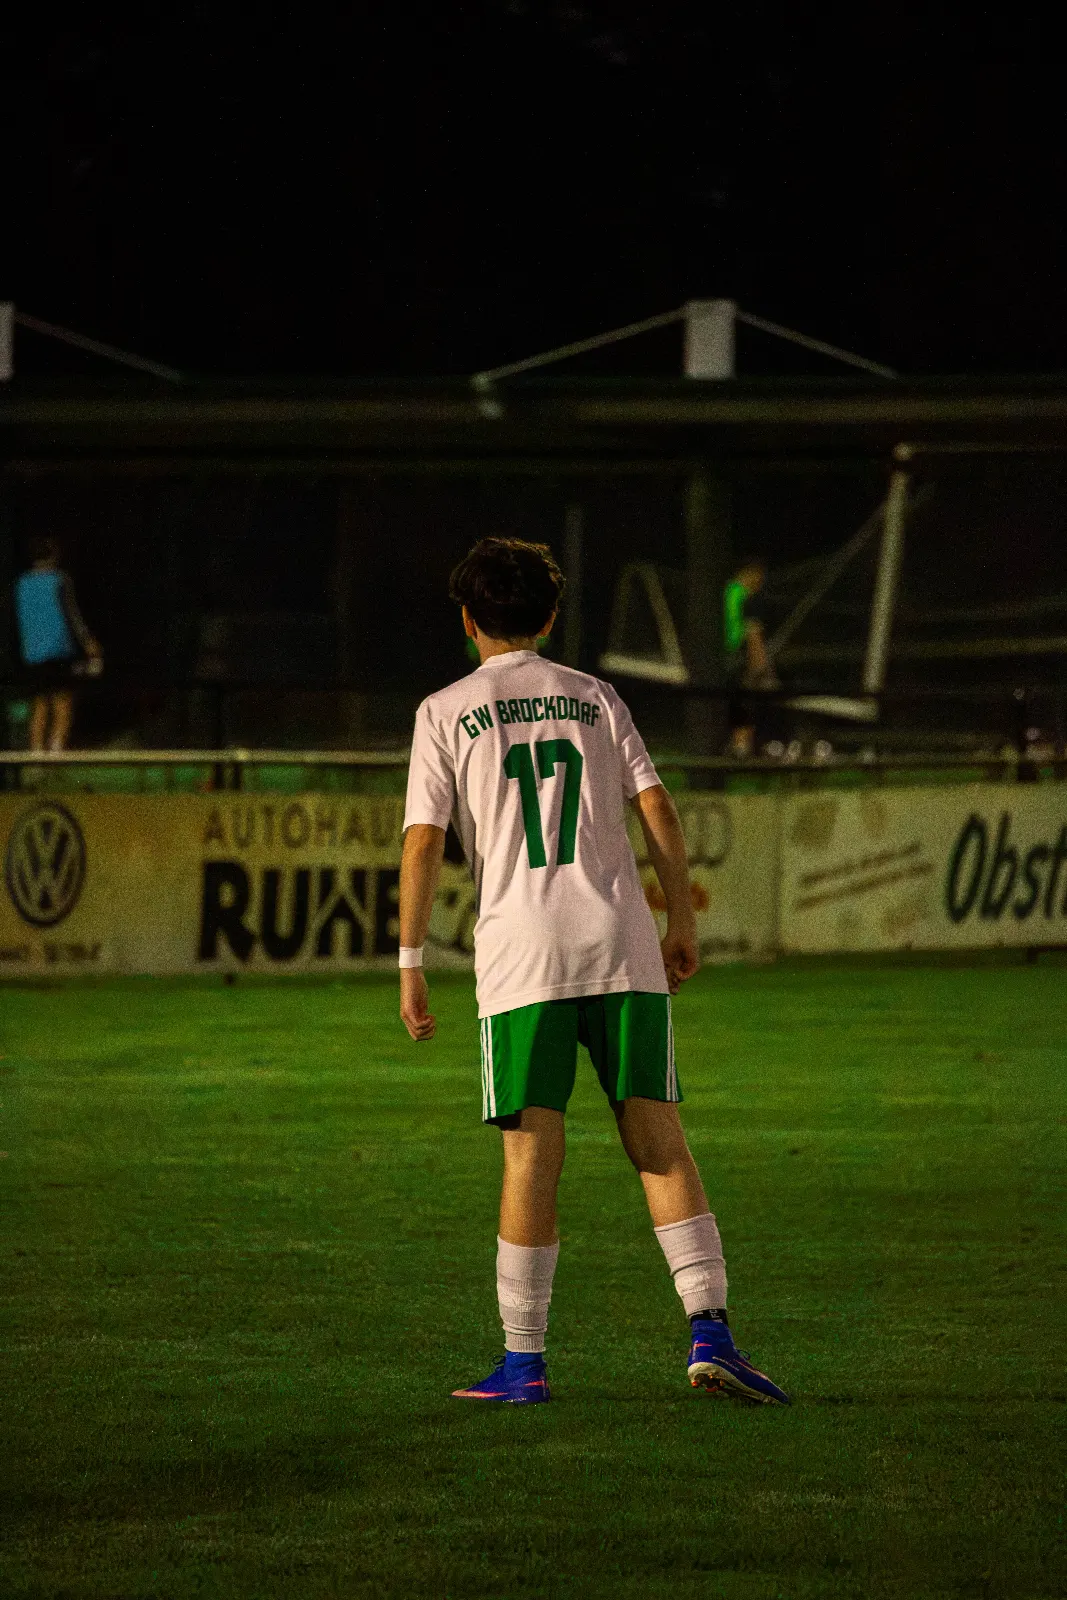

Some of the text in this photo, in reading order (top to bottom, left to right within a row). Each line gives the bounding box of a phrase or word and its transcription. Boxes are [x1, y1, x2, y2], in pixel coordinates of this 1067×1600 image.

[460, 695, 601, 740] GW BROCKDORF
[203, 804, 402, 847] AUTOHAU
[502, 738, 584, 869] 17
[946, 812, 1067, 922] Obst
